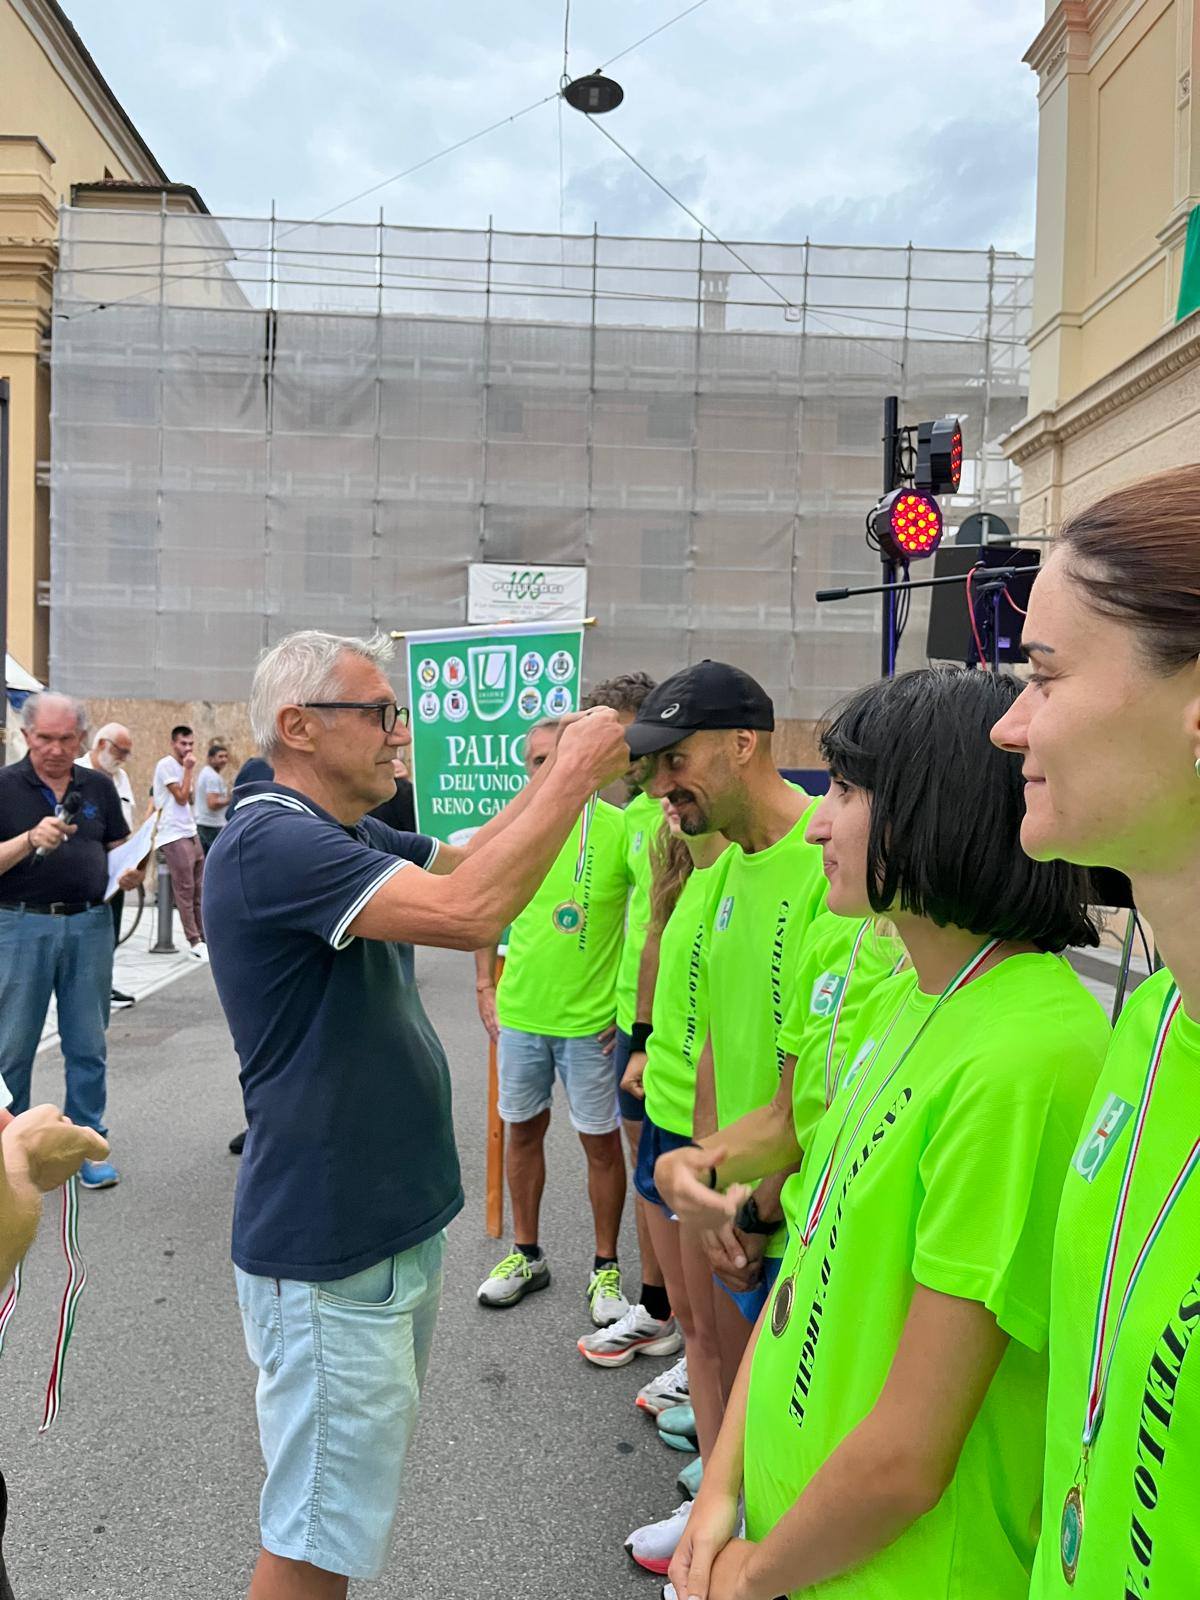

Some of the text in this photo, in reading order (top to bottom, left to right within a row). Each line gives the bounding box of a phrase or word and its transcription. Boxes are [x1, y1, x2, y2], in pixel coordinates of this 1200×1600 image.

[432, 797, 474, 815] RENO
[770, 900, 789, 1004] CASTELLO
[788, 1086, 912, 1428] CASTELLO D'ARGILE
[1133, 1271, 1200, 1510] STELLO
